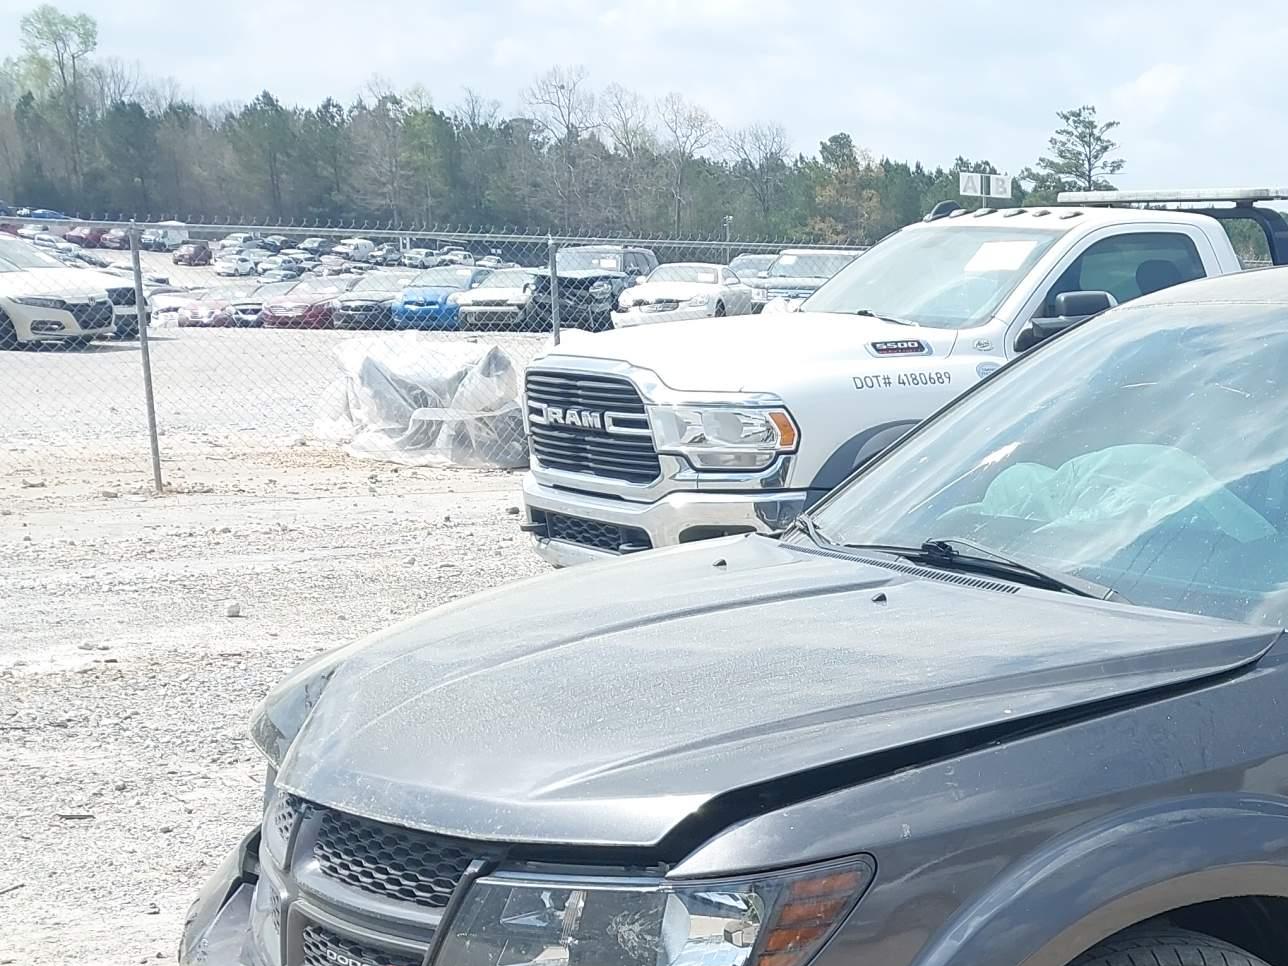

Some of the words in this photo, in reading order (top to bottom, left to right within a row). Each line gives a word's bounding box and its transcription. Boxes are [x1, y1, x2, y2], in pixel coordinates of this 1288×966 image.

[962, 175, 978, 193] A
[995, 177, 1007, 195] B
[875, 341, 919, 350] 5500
[852, 375, 893, 390] DOT#
[897, 371, 951, 387] 4180689
[547, 407, 602, 429] RAM
